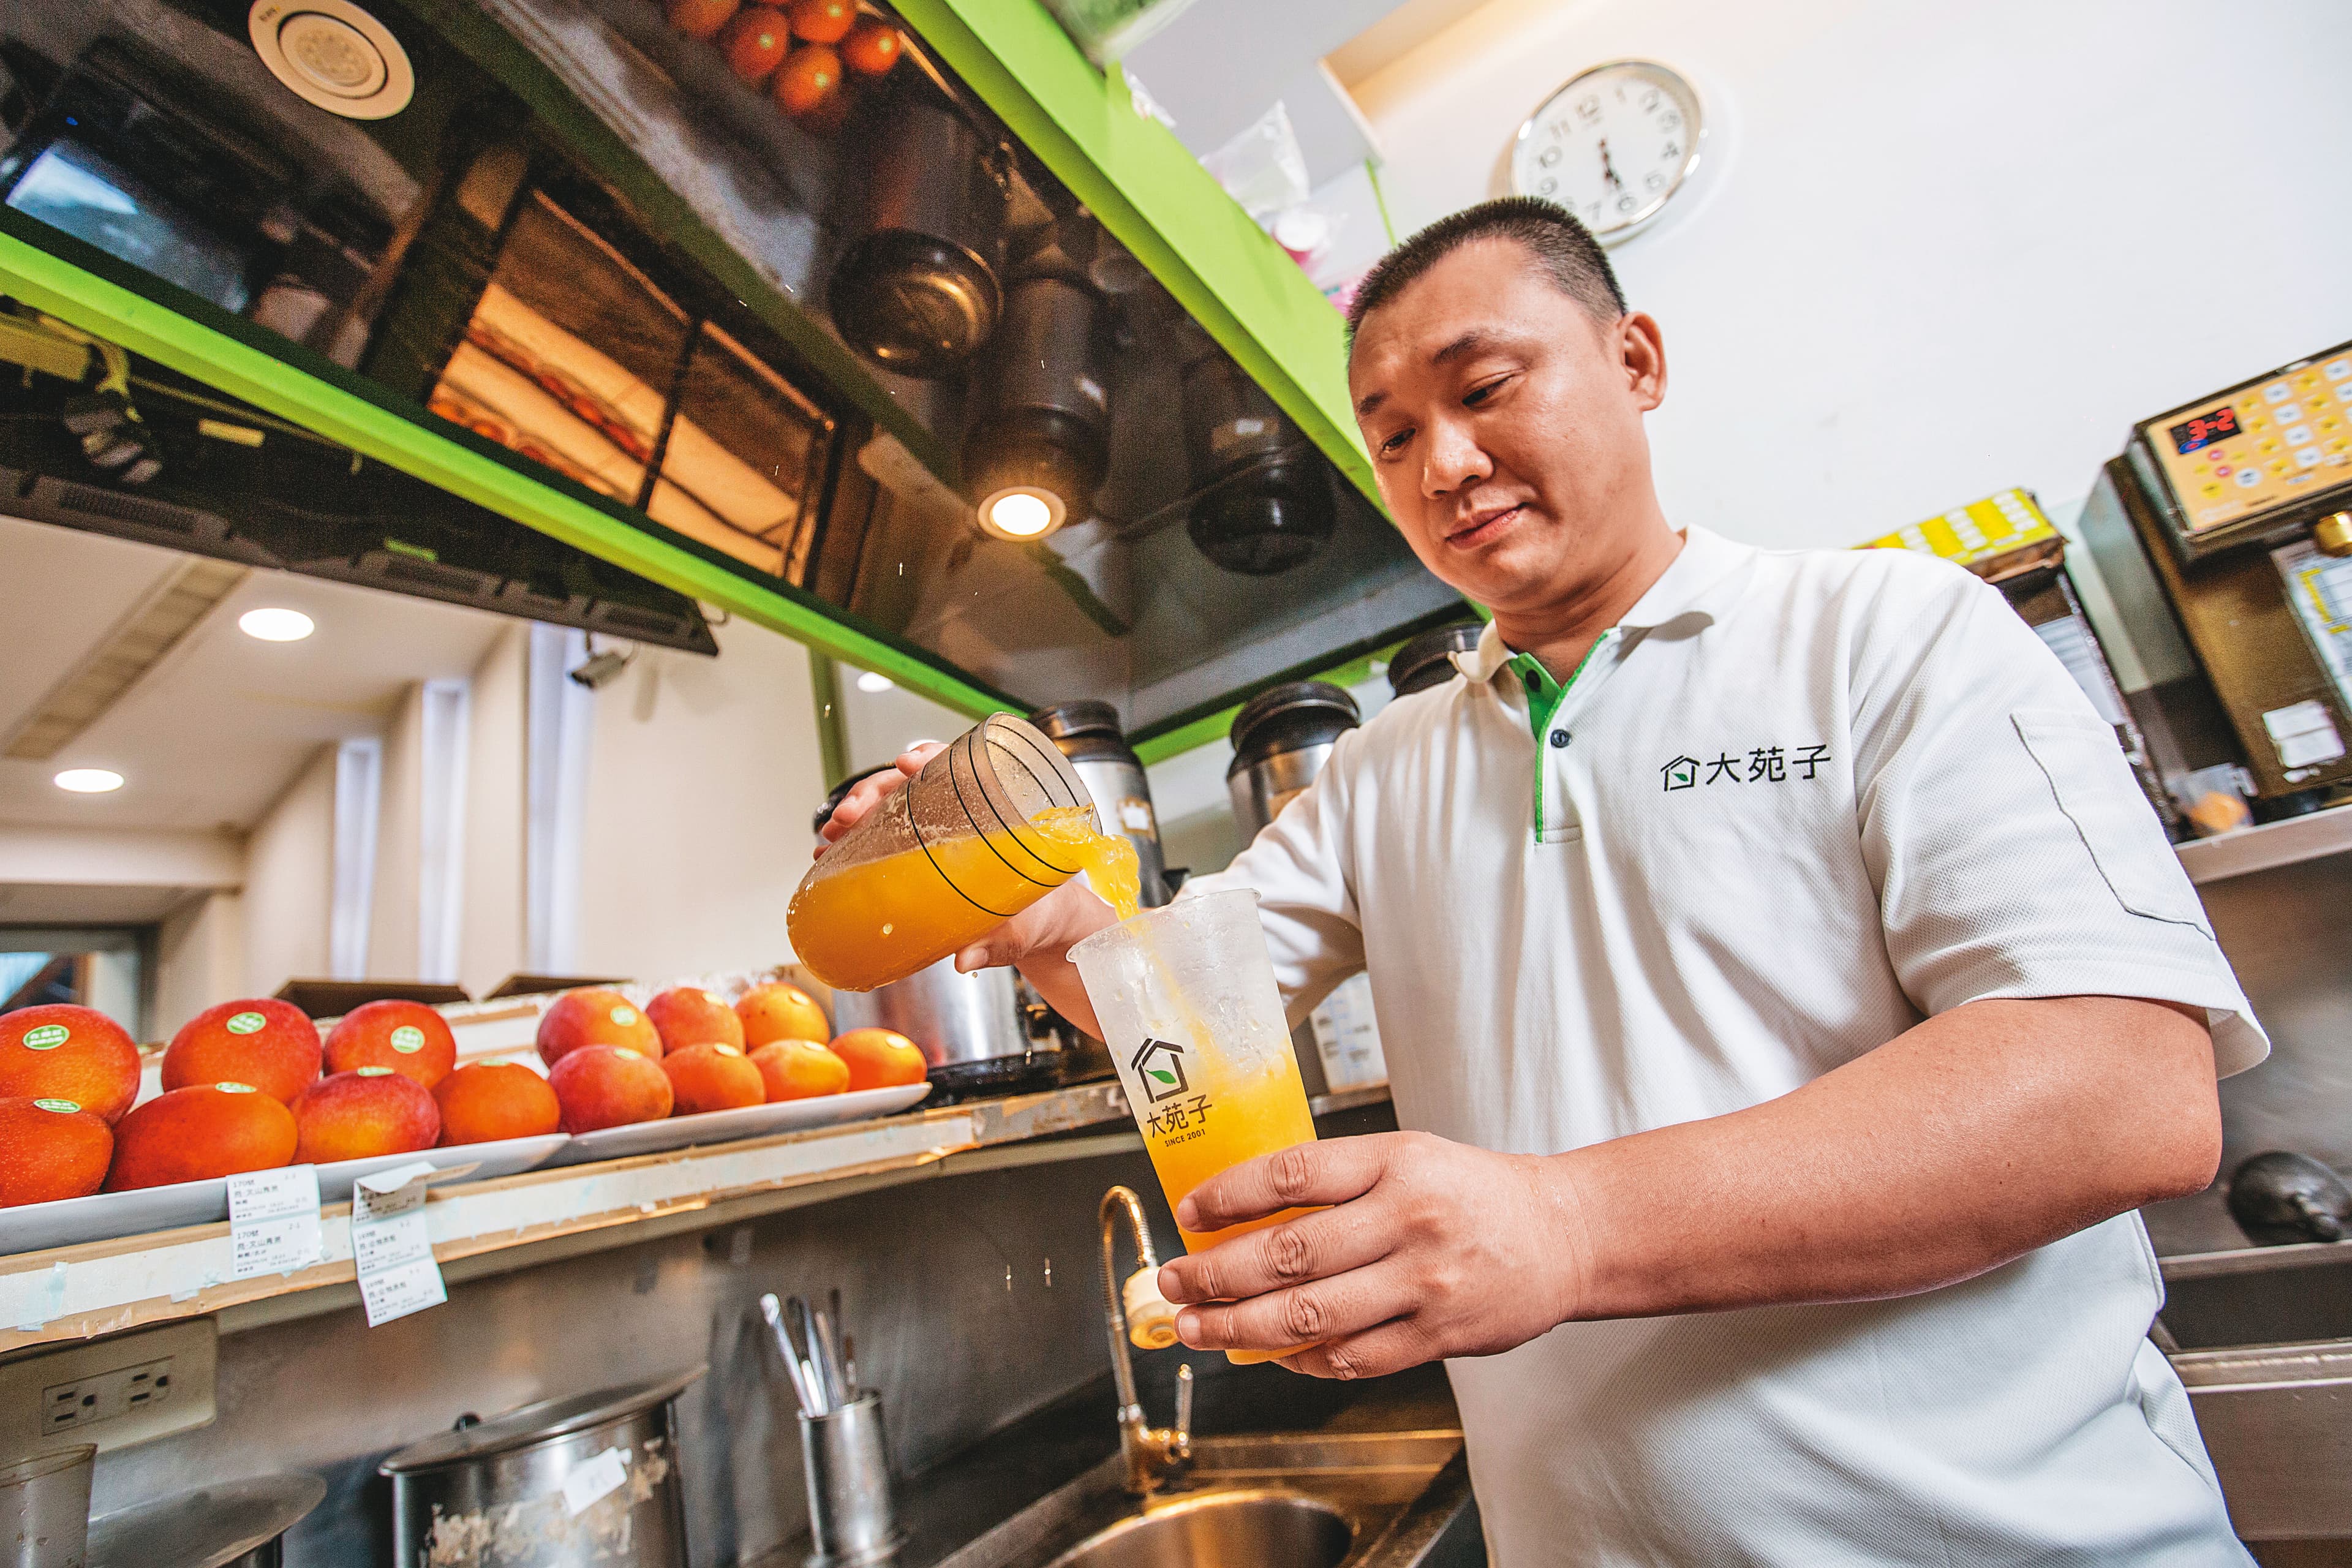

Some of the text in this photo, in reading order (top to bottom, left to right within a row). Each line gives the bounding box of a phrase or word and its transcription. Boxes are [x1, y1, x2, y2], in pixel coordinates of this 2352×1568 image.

[1538, 146, 1564, 170] 10
[1537, 176, 1559, 195] 9
[1706, 744, 1831, 785] 大苑子
[1147, 1095, 1213, 1138] 大苑子
[1165, 1129, 1205, 1147] SINCE 2001
